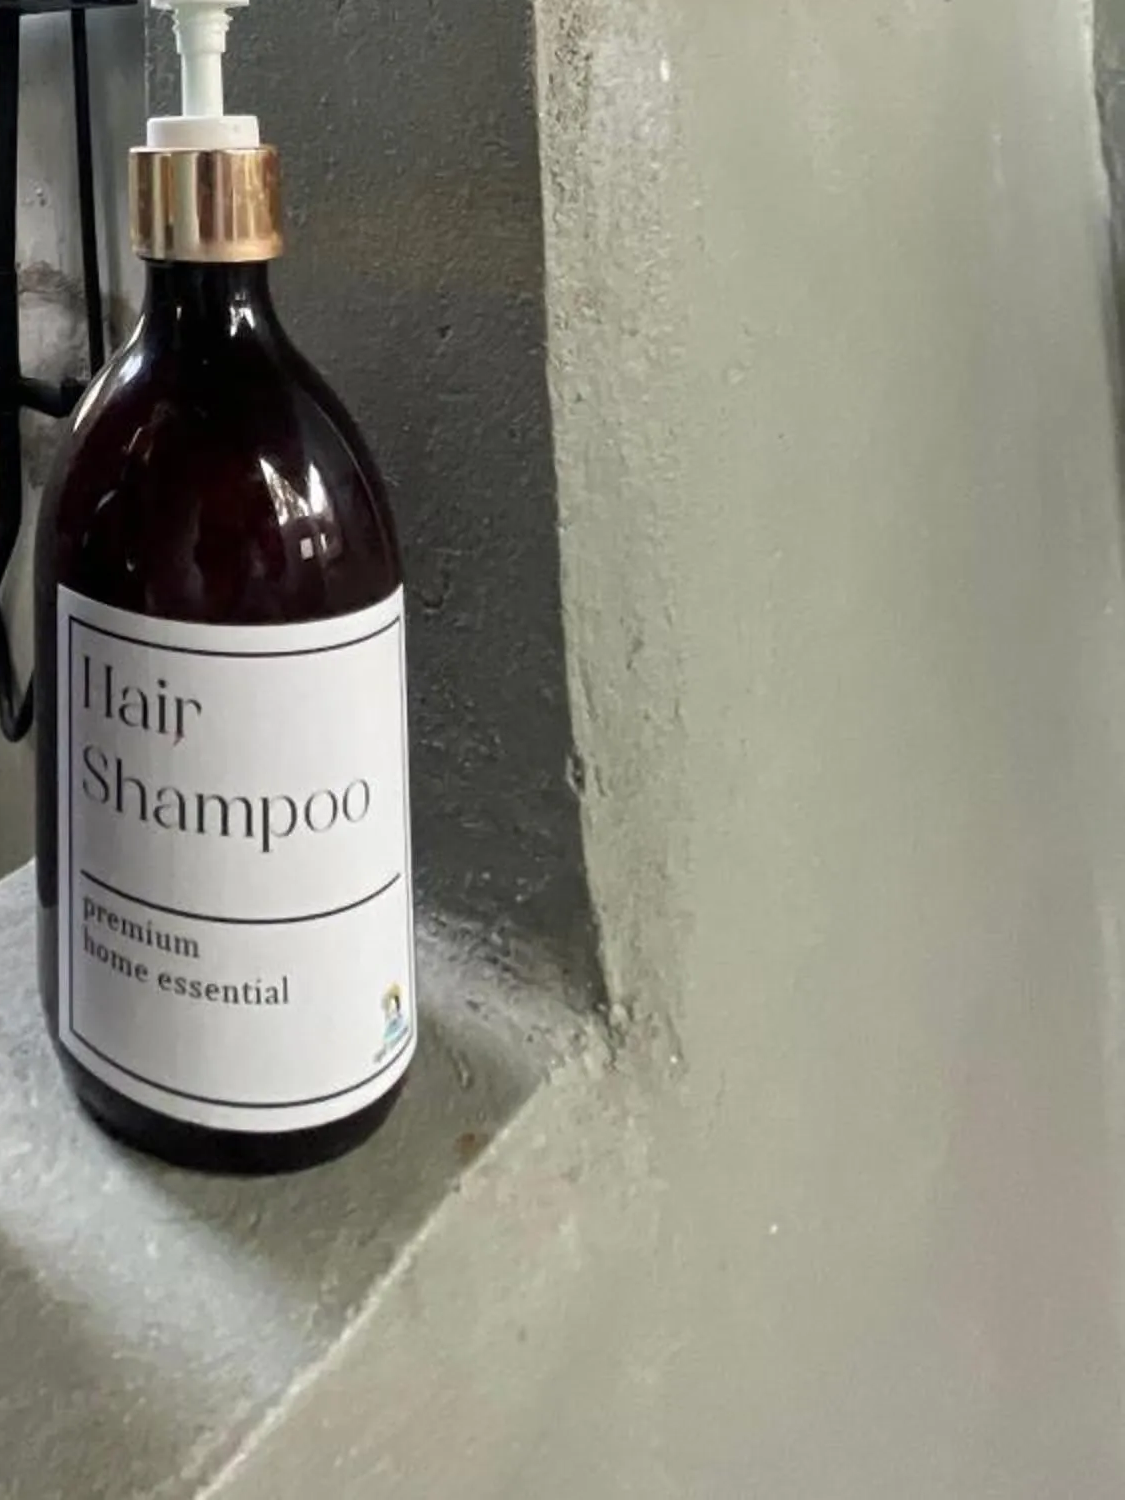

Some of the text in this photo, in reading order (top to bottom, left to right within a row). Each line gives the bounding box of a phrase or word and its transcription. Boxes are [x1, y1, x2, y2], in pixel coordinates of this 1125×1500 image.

[82, 654, 202, 745] Hair
[82, 745, 370, 853] Shampoo
[82, 924, 289, 1005] home essential
[83, 896, 200, 958] premium
